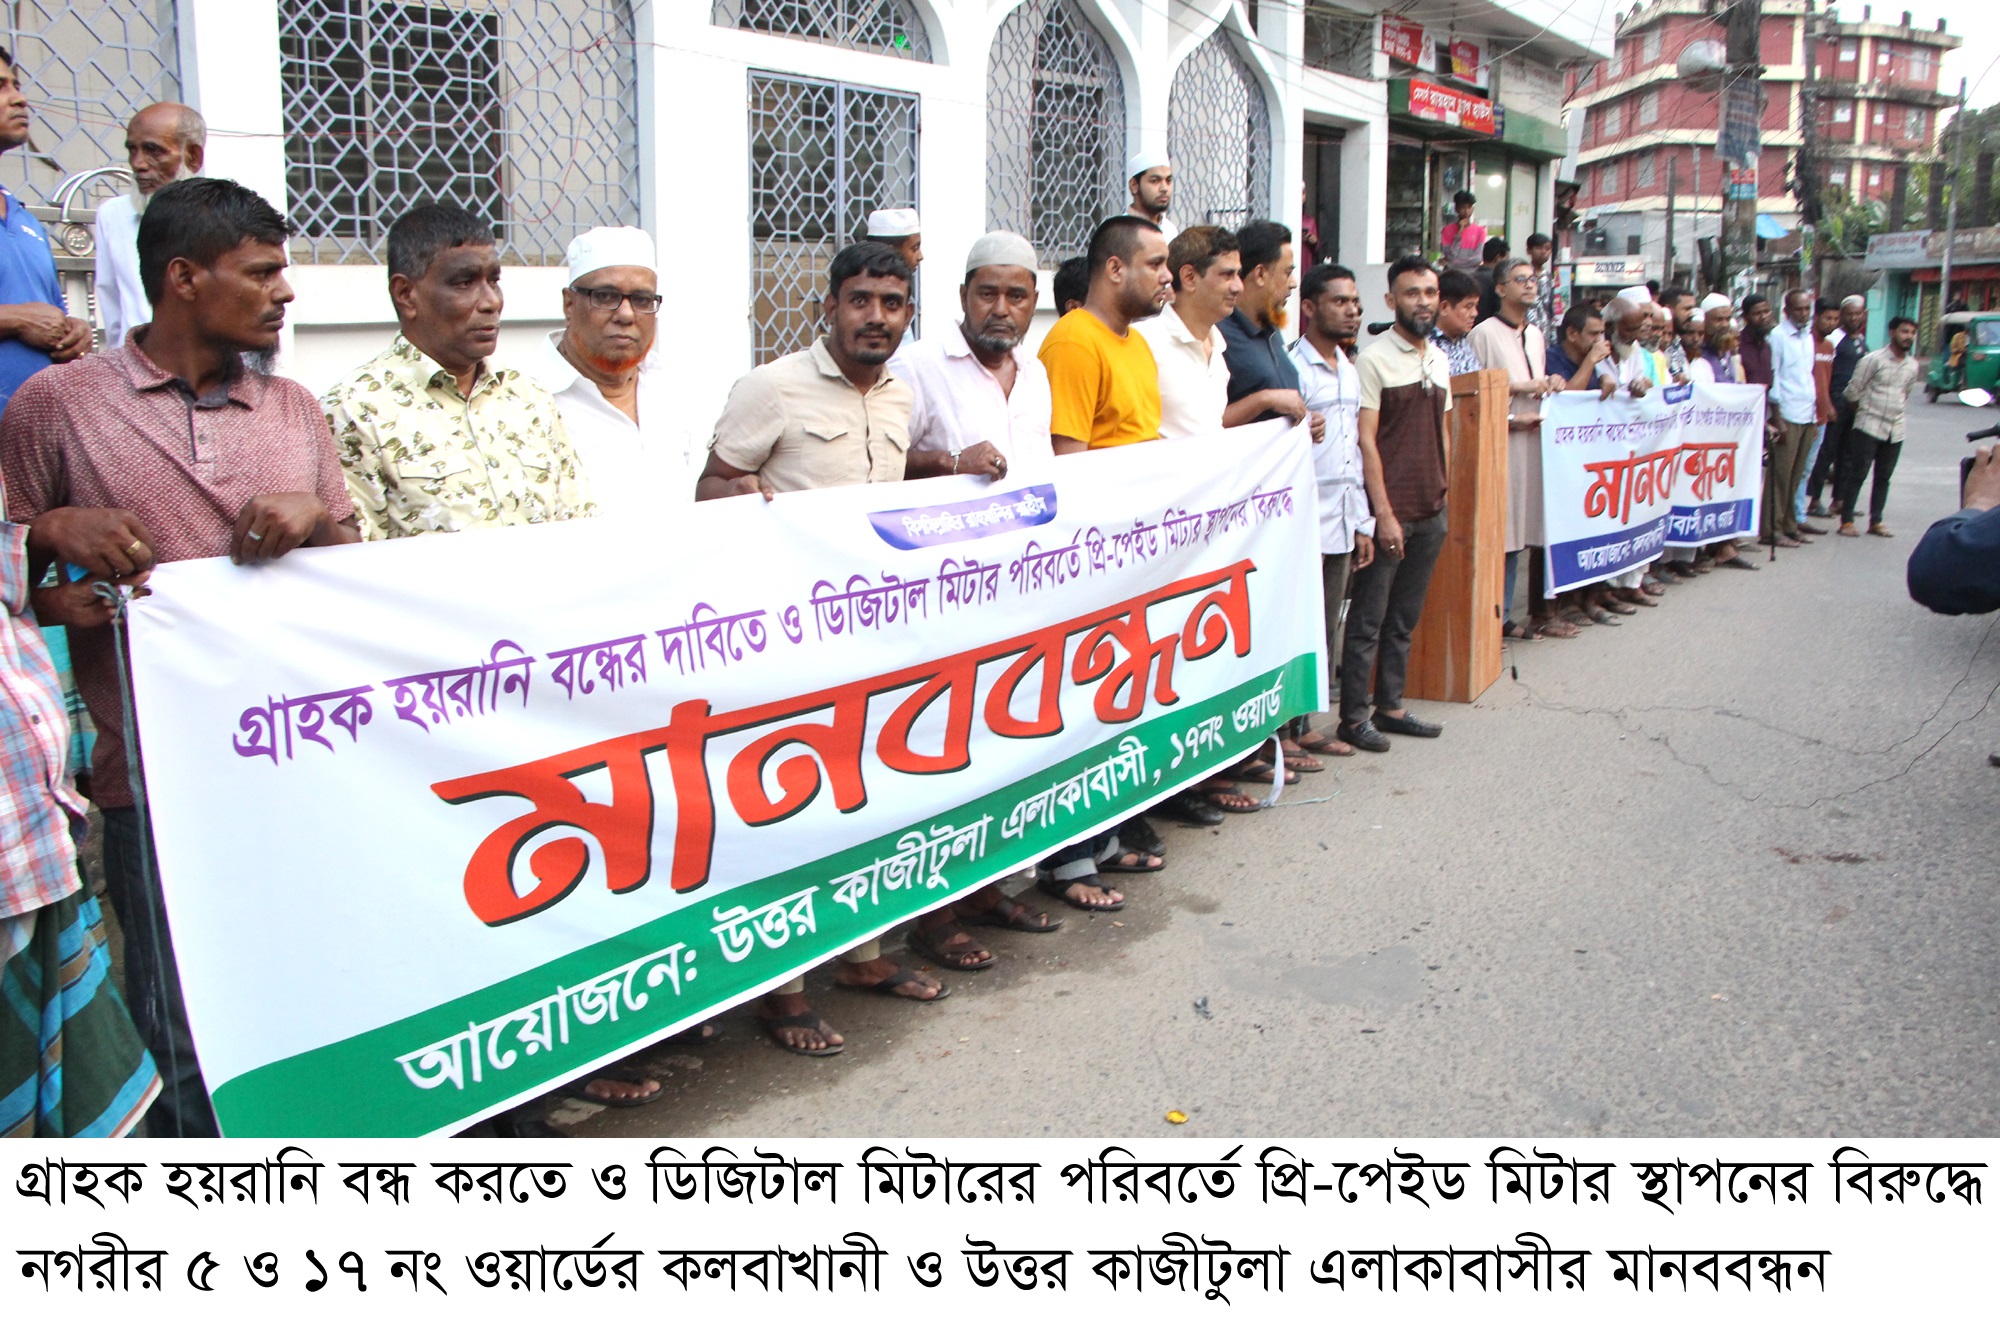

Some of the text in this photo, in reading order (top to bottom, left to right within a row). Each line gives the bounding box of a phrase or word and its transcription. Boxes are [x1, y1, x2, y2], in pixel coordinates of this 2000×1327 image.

[232, 484, 1294, 766] গ্রাহক হয়রানি বন্ধের দাবিতে ও ডিজিটাল মিটার পরিবর্তে প্রি-পেইড মিটার স্থাপনের বিরুদ্ধে
[430, 557, 1257, 927] মানববন্ধন
[710, 885, 820, 964] উত্তর
[828, 812, 995, 914] কাজীটুলা
[1231, 670, 1284, 733] ওয়ার্ড
